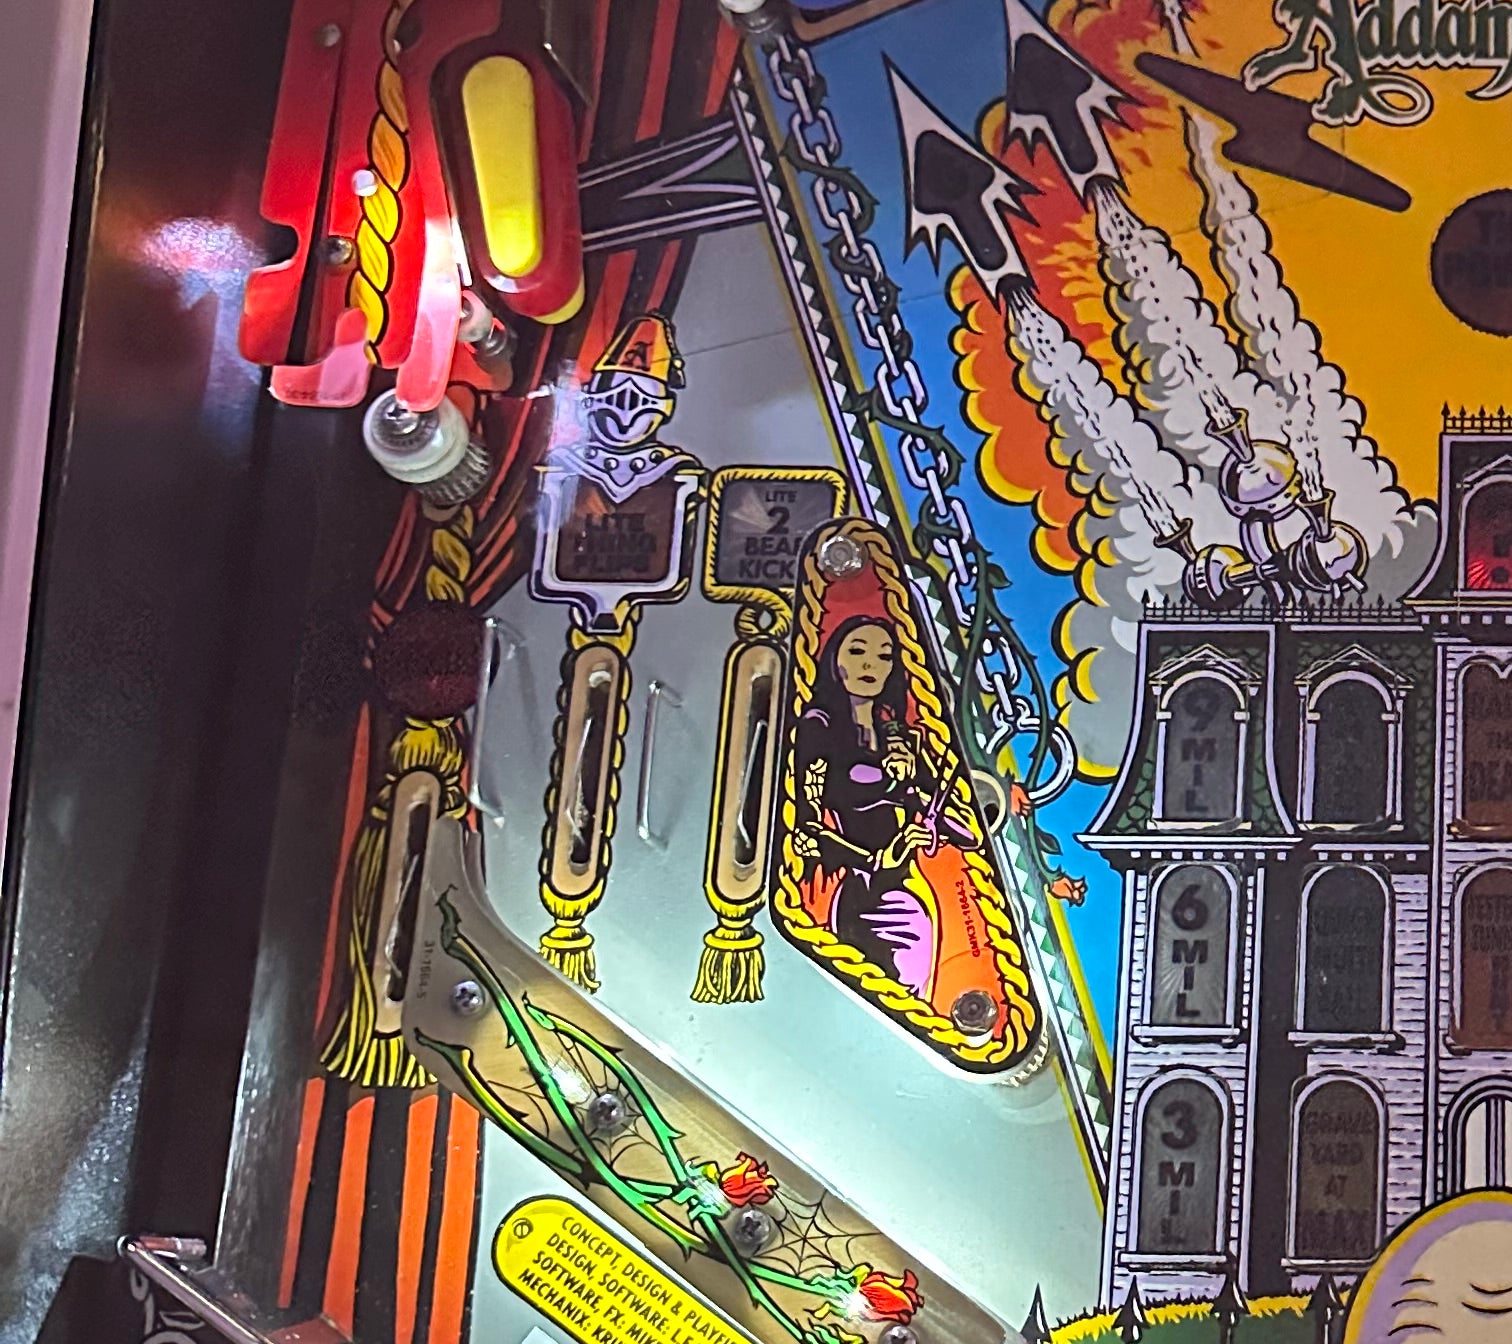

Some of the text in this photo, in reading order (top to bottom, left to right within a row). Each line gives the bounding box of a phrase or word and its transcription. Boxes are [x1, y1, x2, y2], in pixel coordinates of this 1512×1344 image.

[765, 491, 797, 503] LITE
[767, 508, 789, 534] 2
[1172, 885, 1208, 931] 6
[1161, 1101, 1199, 1149] 3
[533, 1252, 600, 1313] SOFTWARE,
[603, 1305, 626, 1330] FX:
[546, 1233, 596, 1285] DESIGN,
[598, 1273, 671, 1337] SOFTWARE:
[561, 1216, 622, 1271] CONCEPT,
[621, 1262, 671, 1305] DESIGN
[670, 1301, 682, 1315] &
[518, 1269, 592, 1332] MECHANIX:
